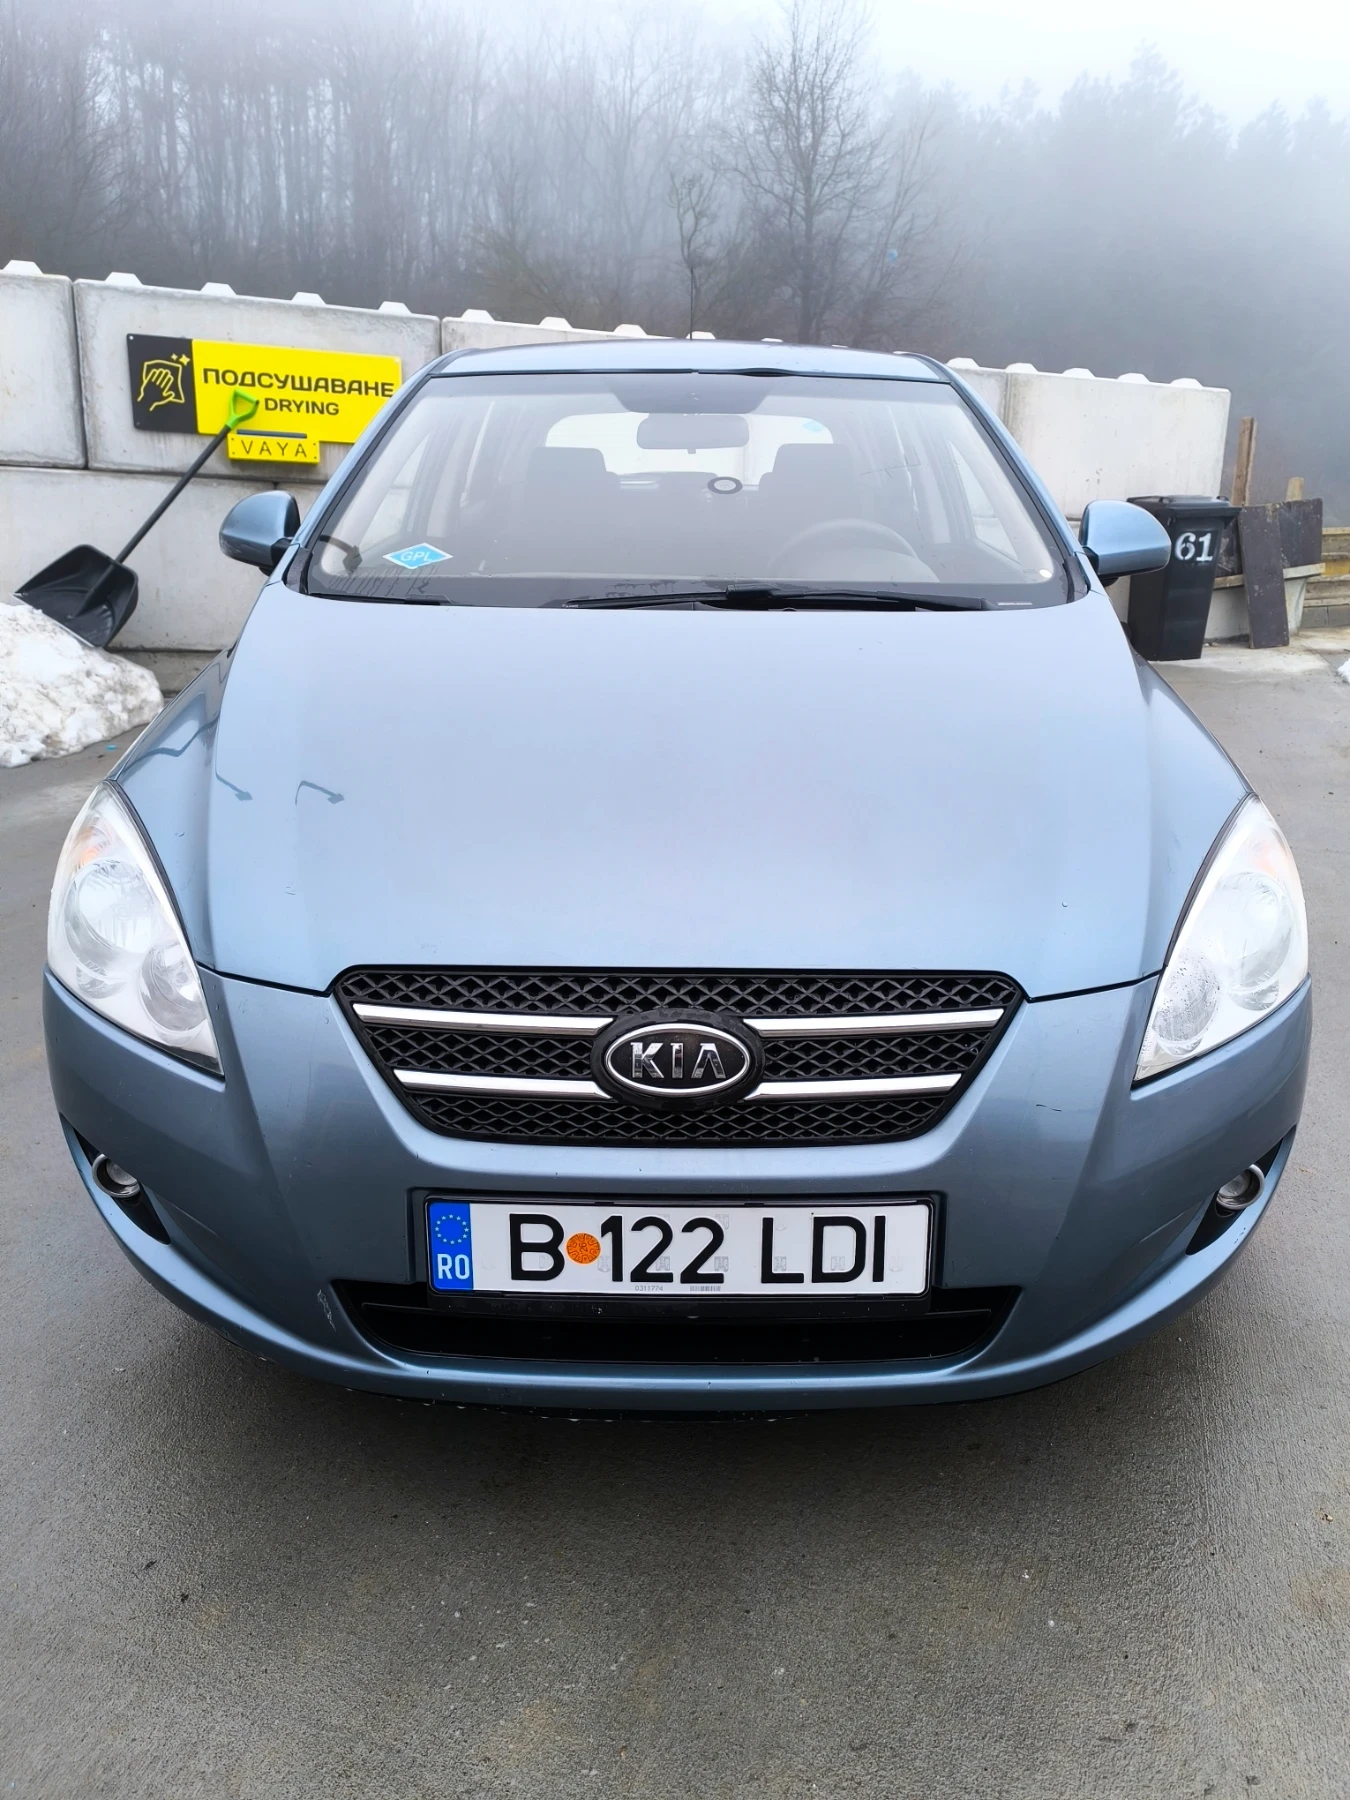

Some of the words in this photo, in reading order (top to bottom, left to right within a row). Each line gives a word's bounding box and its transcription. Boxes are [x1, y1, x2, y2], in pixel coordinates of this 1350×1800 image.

[202, 367, 395, 398] ПОДСУШАВАНЕ
[264, 397, 340, 416] DRYING
[241, 439, 308, 458] VAYA
[400, 551, 434, 562] GPL
[1175, 532, 1213, 561] 61
[630, 1042, 727, 1078] KIA
[509, 1213, 565, 1281] B
[601, 1215, 725, 1284] 122
[761, 1215, 886, 1283] LDI
[437, 1253, 470, 1280] RO
